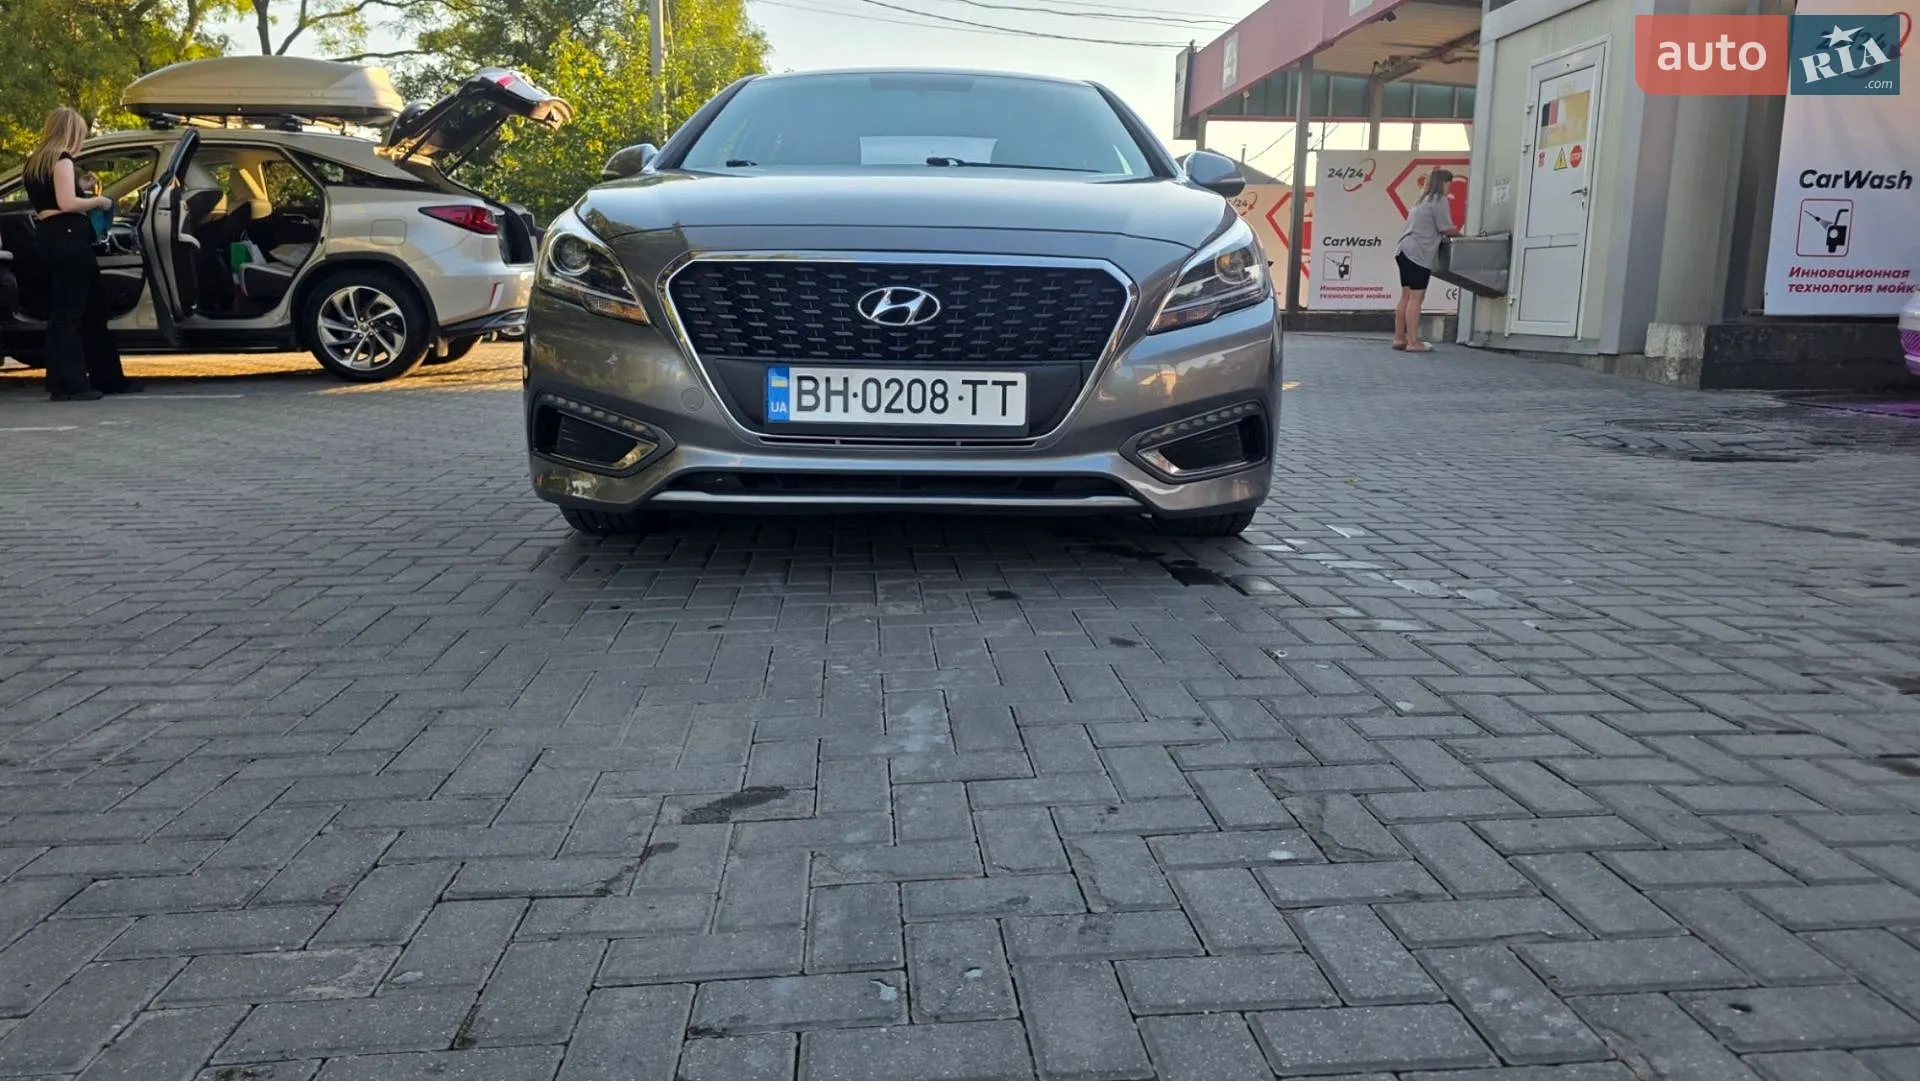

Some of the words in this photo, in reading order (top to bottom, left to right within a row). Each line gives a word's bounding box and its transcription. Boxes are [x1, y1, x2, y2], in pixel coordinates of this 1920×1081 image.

[1327, 166, 1364, 179] 24/24
[1799, 169, 1913, 190] CarWash
[1323, 236, 1382, 247] CarWash
[1788, 266, 1911, 280] Инновационная
[1788, 283, 1874, 294] технология
[1876, 281, 1916, 294] мойк
[770, 401, 788, 414] UA
